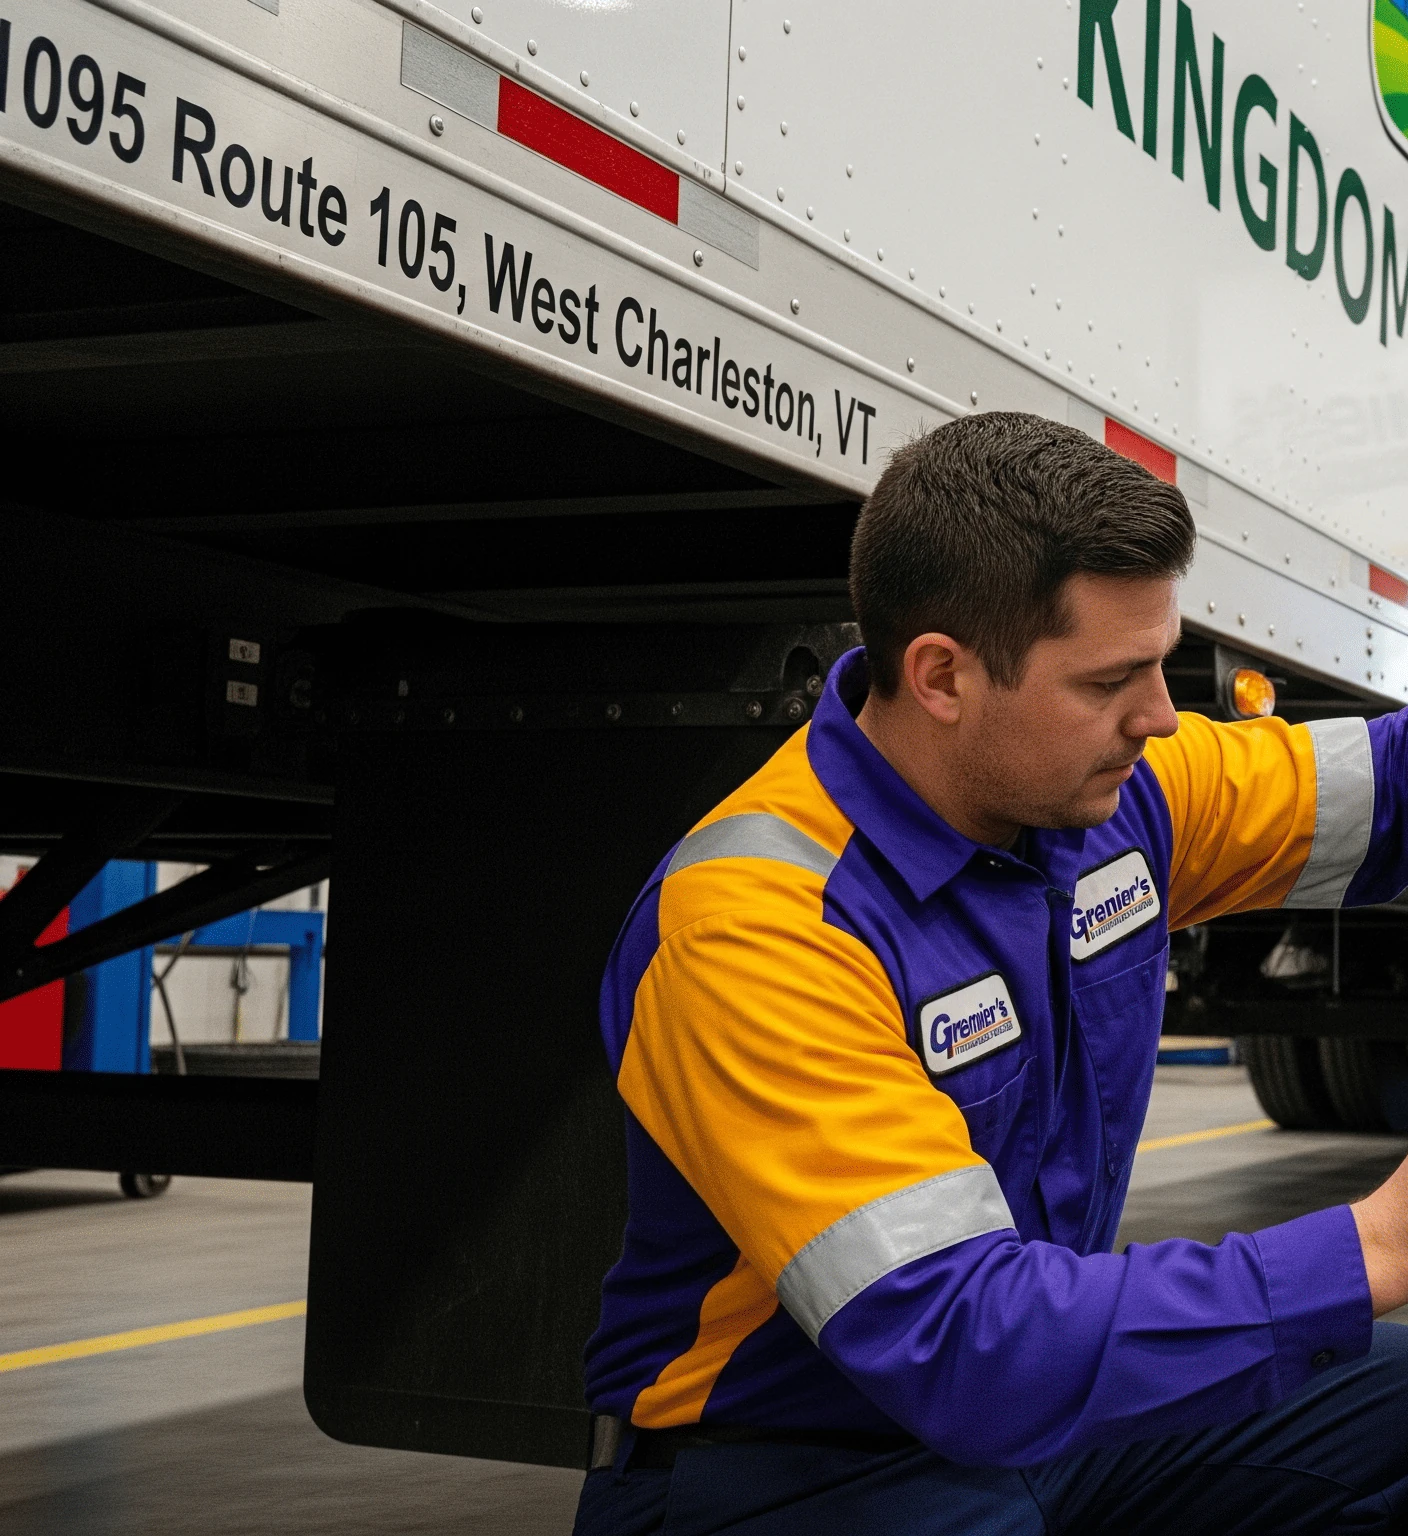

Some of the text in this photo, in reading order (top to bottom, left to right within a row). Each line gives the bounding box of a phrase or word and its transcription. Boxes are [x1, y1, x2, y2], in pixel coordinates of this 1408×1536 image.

[173, 97, 348, 247] Route
[371, 187, 465, 315] 105,
[485, 233, 599, 354] West
[616, 297, 822, 457] Charleston,
[835, 389, 877, 465] VT
